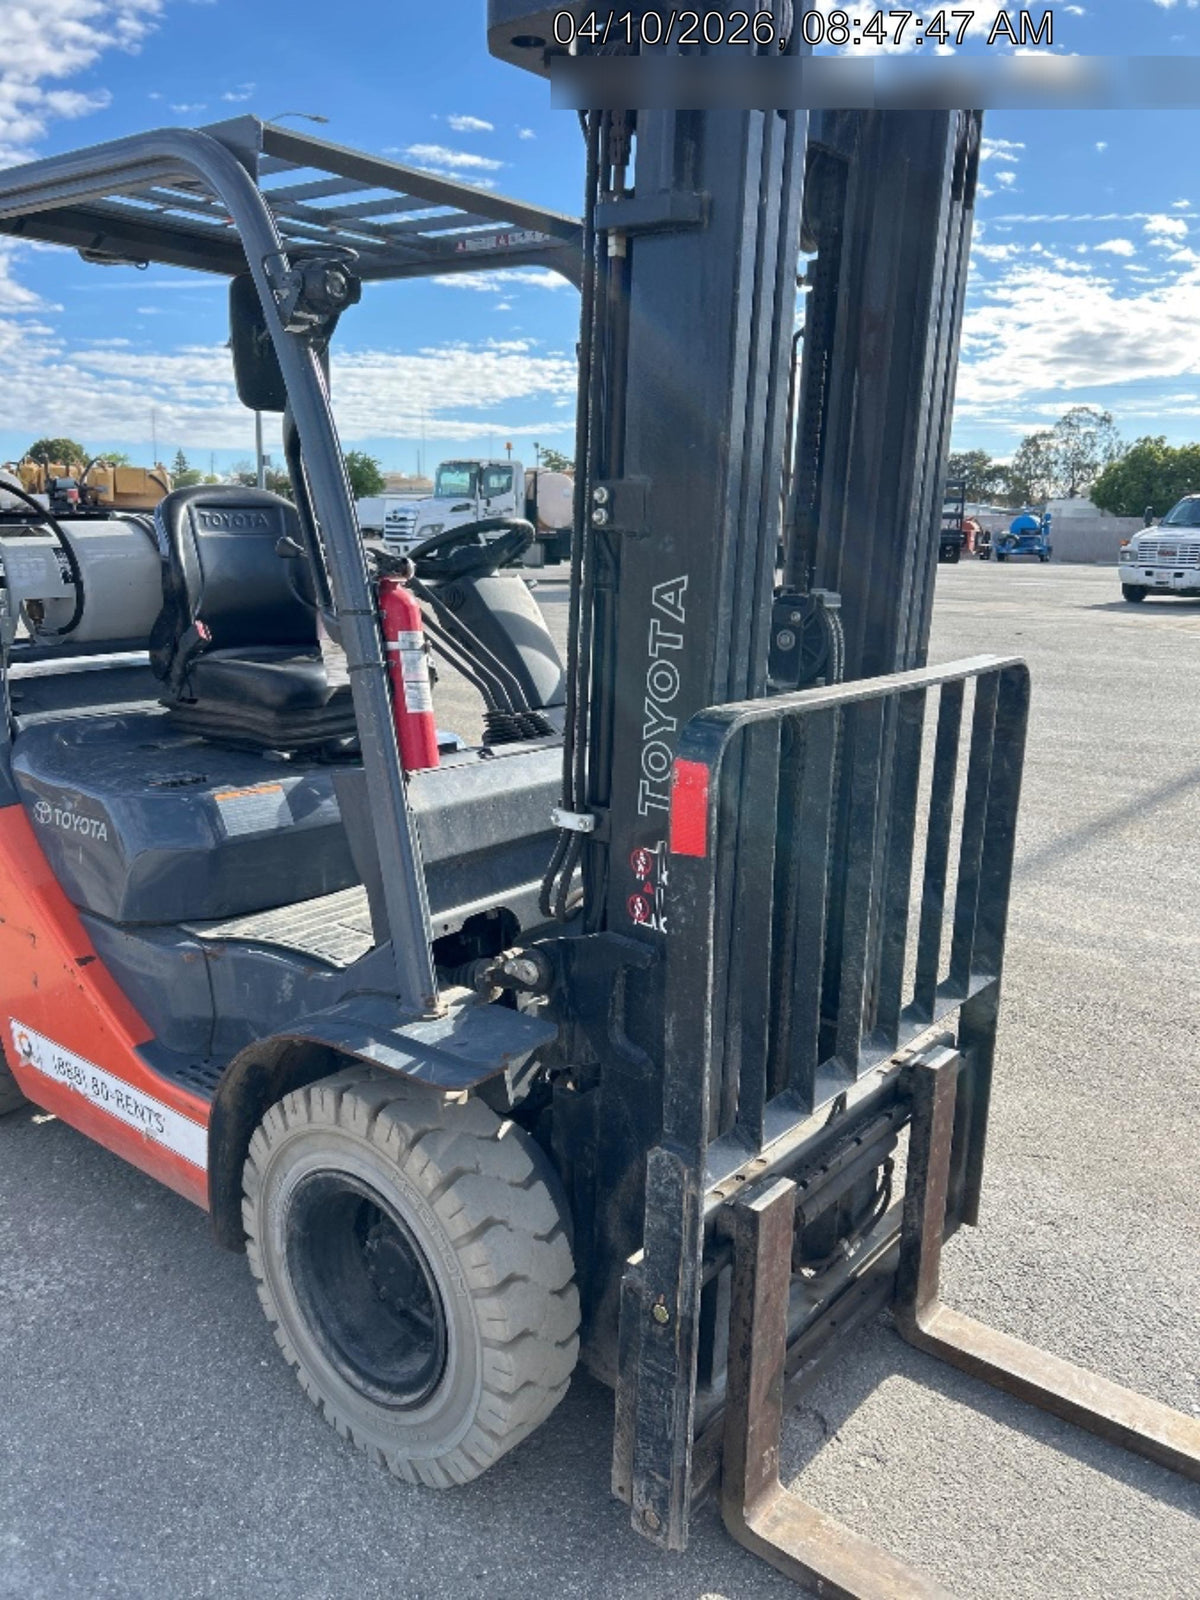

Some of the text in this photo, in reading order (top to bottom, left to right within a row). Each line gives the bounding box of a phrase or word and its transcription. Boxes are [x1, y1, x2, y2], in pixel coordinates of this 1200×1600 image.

[200, 511, 270, 528] TOYOTA
[638, 574, 689, 816] TOYOTA
[54, 808, 107, 842] TOYOTA
